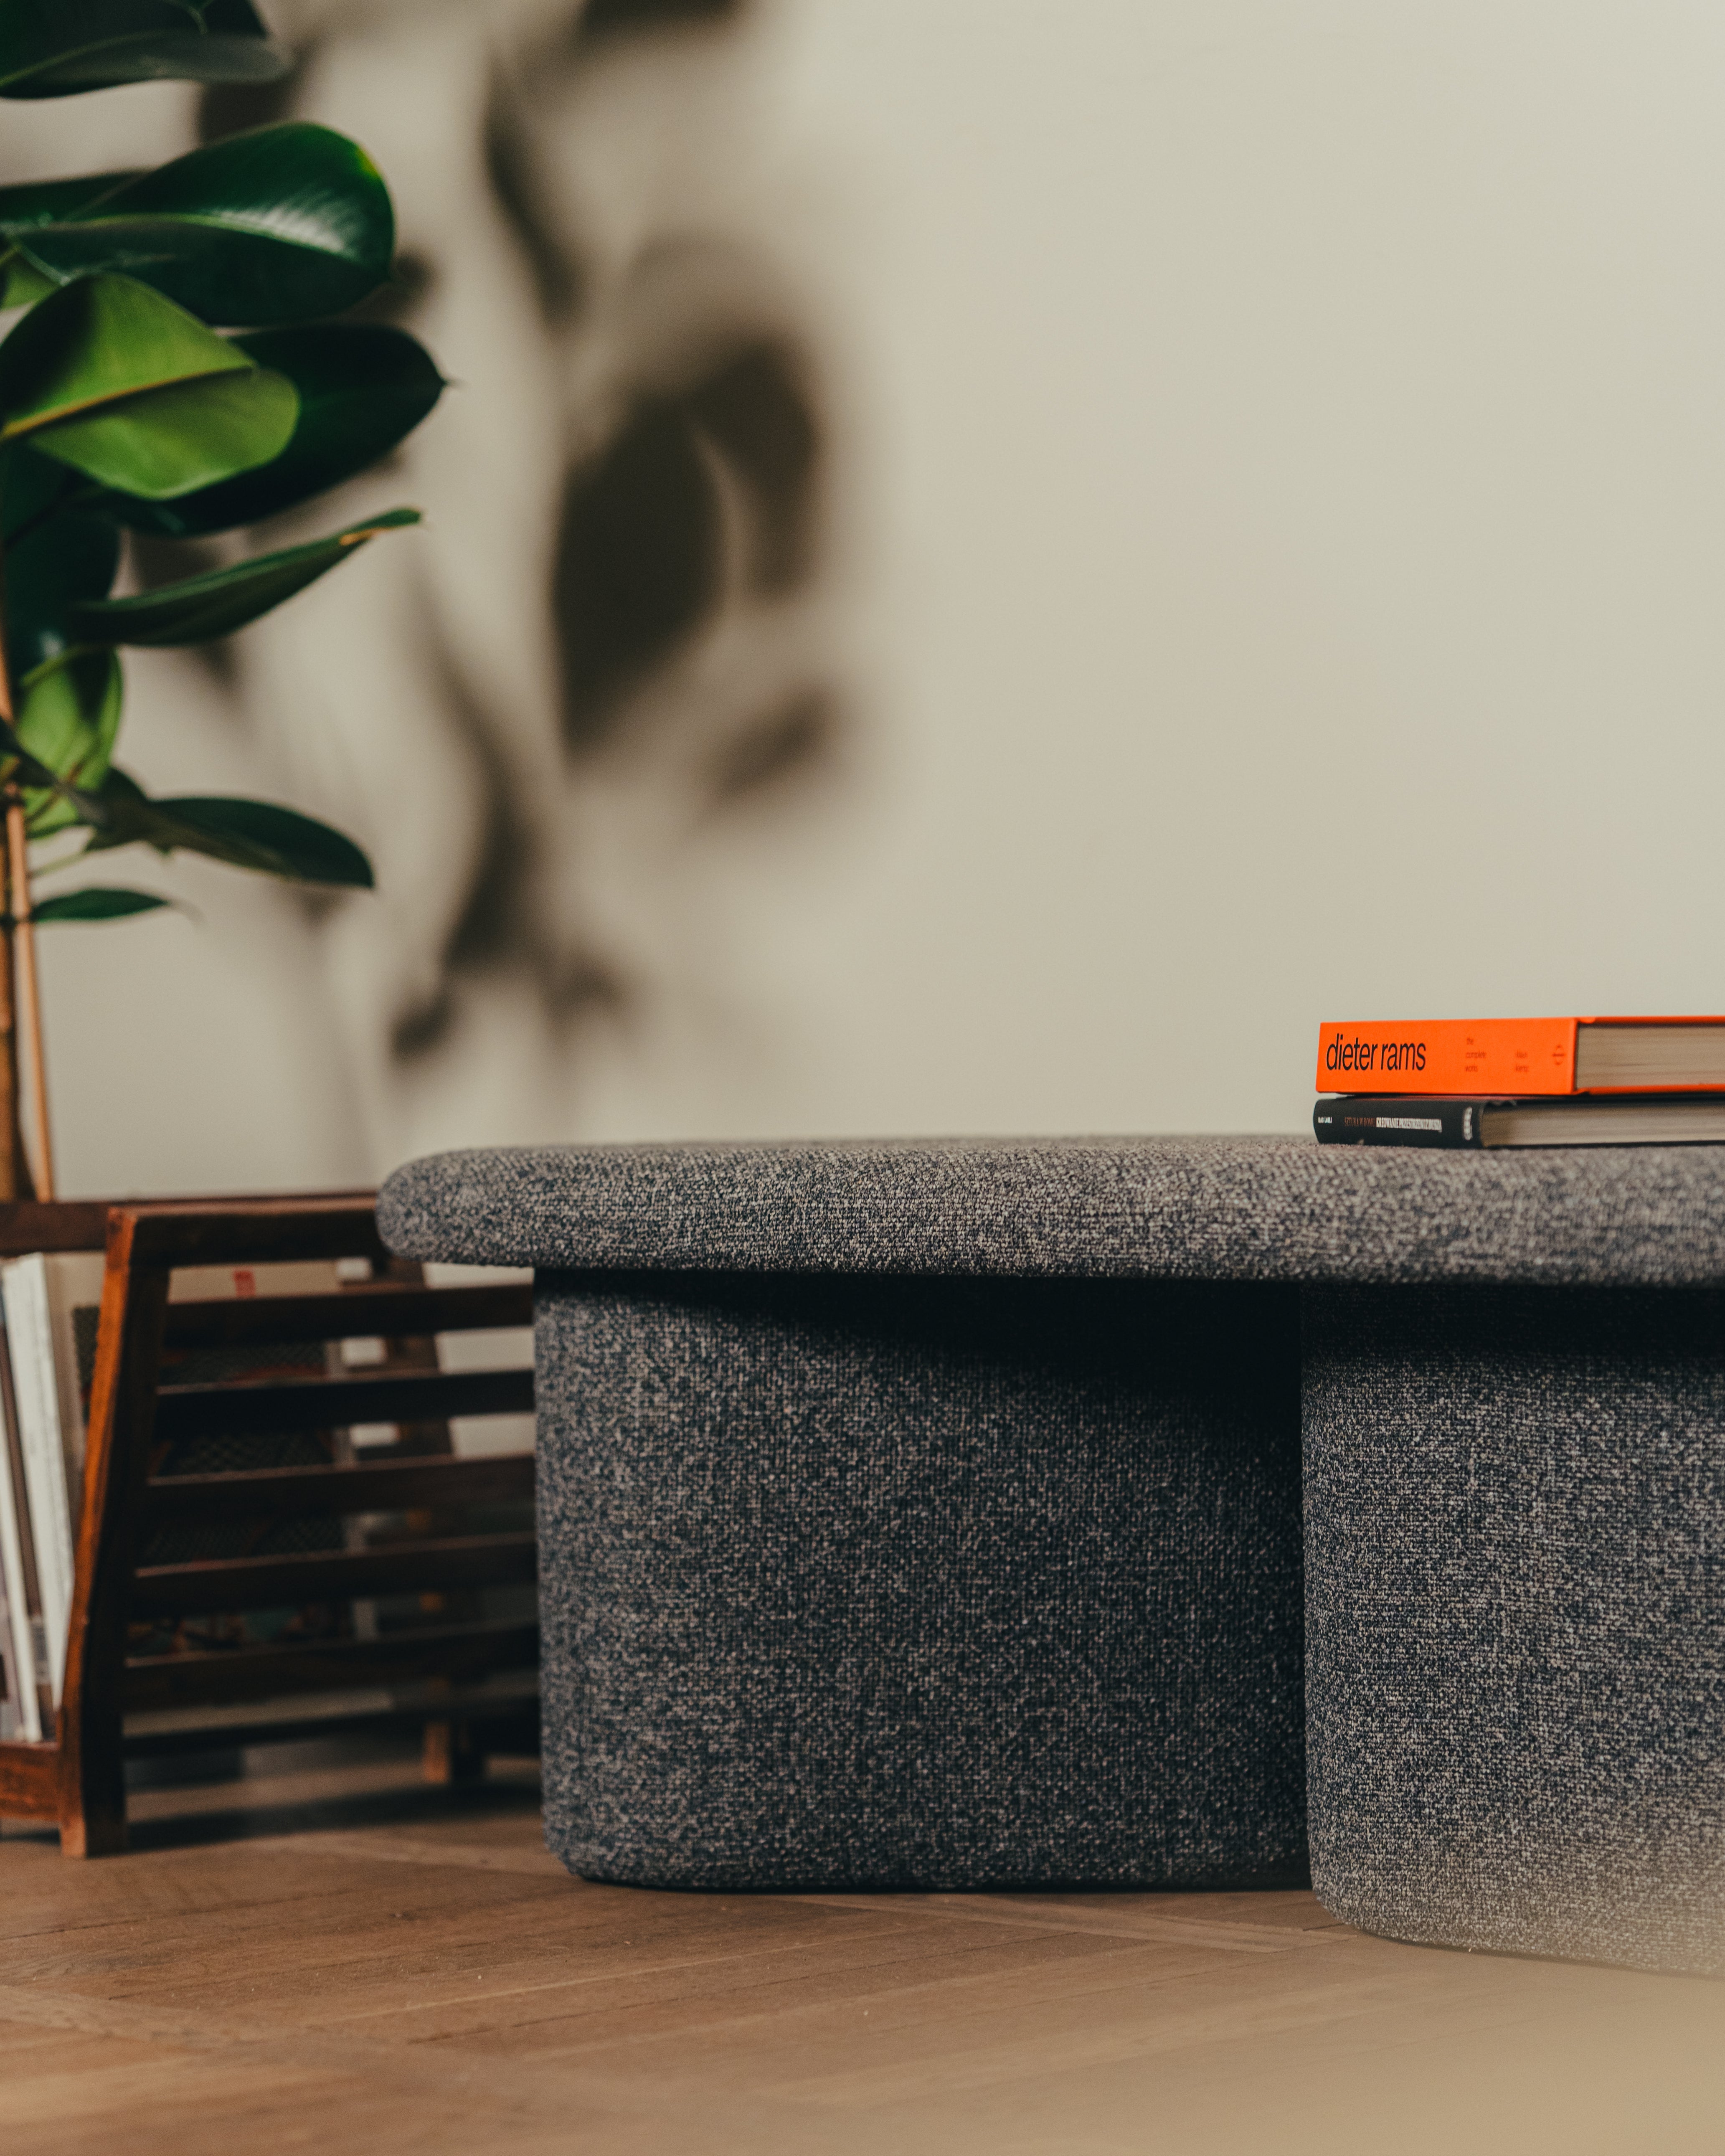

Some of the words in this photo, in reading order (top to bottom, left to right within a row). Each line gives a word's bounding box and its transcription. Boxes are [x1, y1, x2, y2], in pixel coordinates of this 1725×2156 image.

[1326, 1033, 1378, 1070] dieter
[1381, 1042, 1426, 1070] rams
[1376, 1117, 1399, 1128] KREOWANIE
